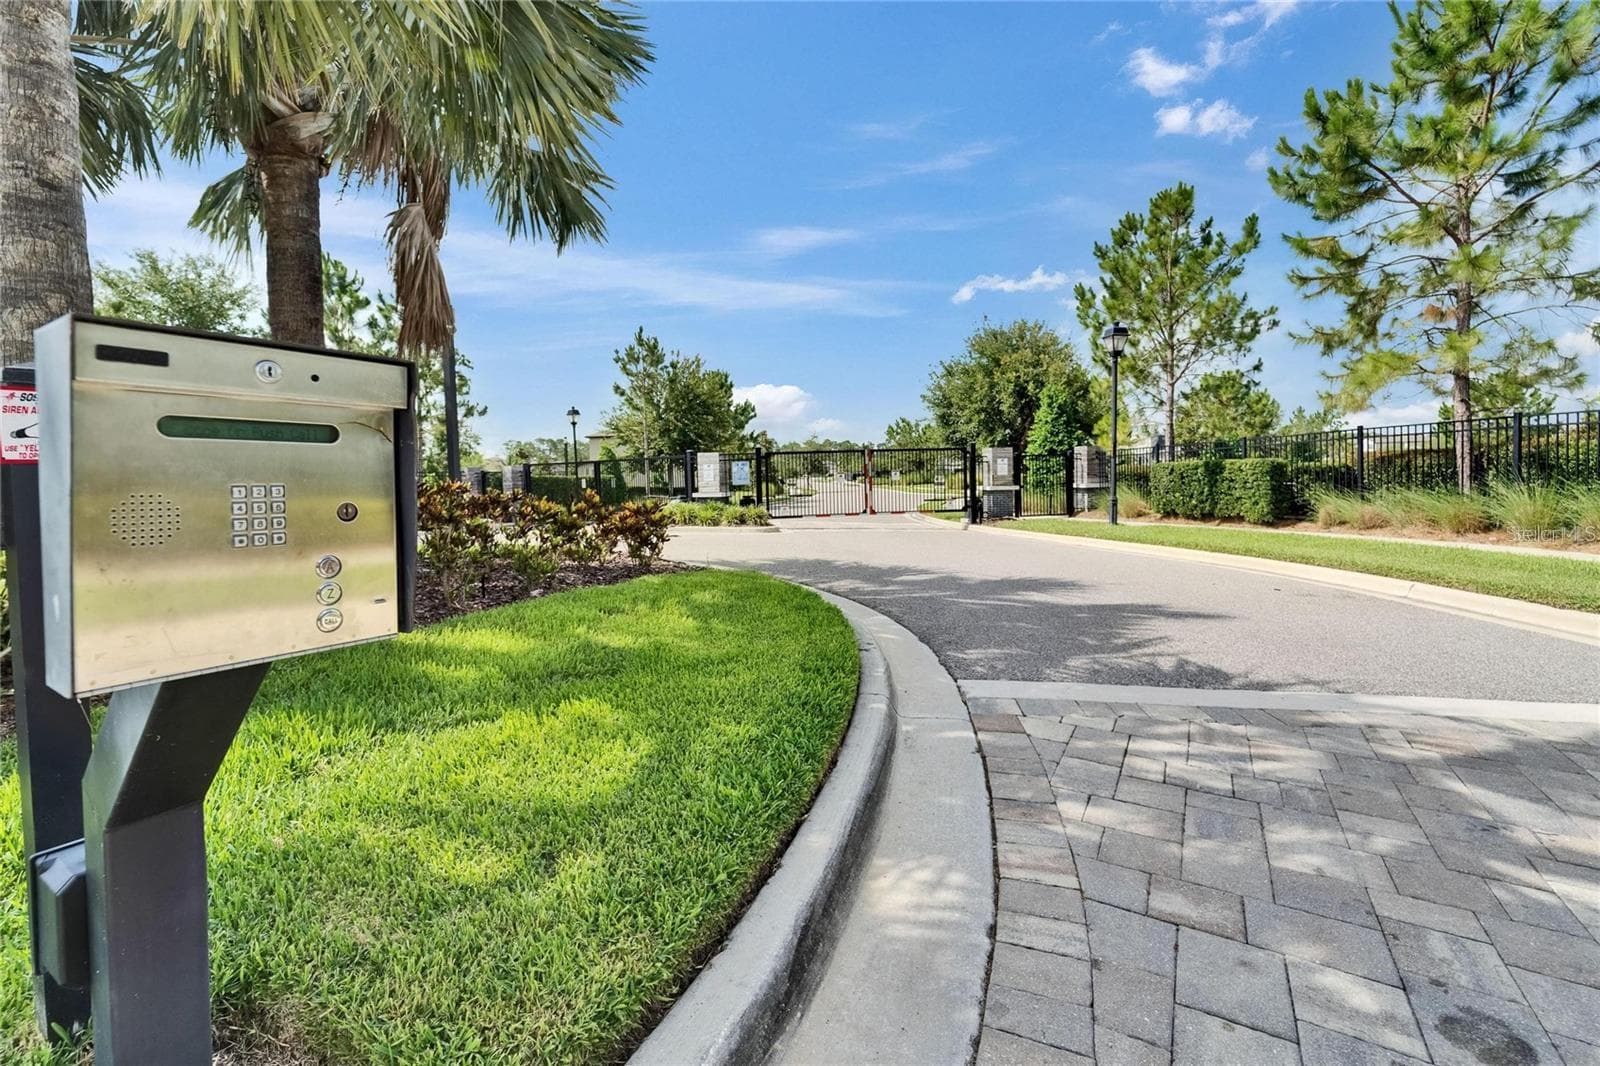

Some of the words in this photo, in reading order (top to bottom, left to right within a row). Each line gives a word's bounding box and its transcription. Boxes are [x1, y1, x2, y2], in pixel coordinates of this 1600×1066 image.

[2, 405, 29, 414] SIREN
[255, 488, 263, 496] 2
[274, 488, 281, 496] 3
[256, 504, 263, 512] 5
[236, 520, 245, 529] 7
[256, 520, 264, 528] 8
[275, 519, 283, 527] 9
[326, 588, 336, 599] Z
